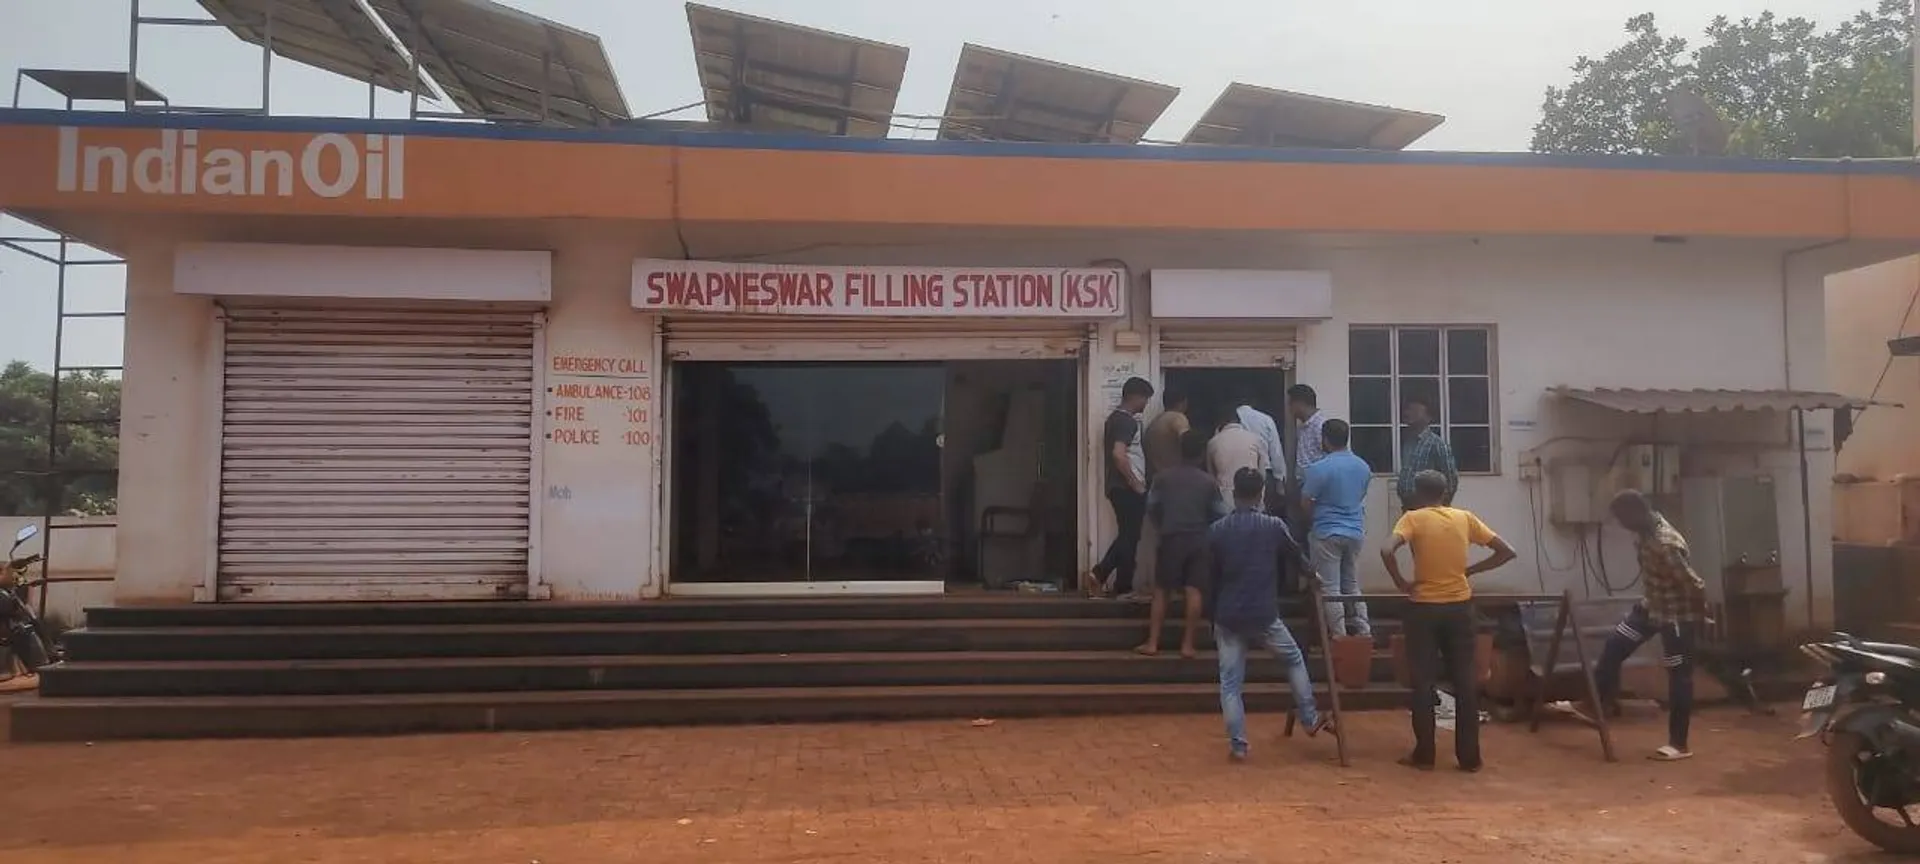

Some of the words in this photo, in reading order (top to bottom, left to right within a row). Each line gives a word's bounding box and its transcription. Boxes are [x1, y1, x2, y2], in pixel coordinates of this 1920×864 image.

[57, 126, 404, 200] IndianOil
[647, 271, 834, 307] SWAPNESWAR
[846, 273, 944, 308] FILLING
[953, 274, 1053, 308] STATION
[553, 356, 615, 373] EMERGENCY
[618, 358, 647, 373] CALL
[555, 406, 584, 421] FIRE
[554, 428, 599, 445] POLICE
